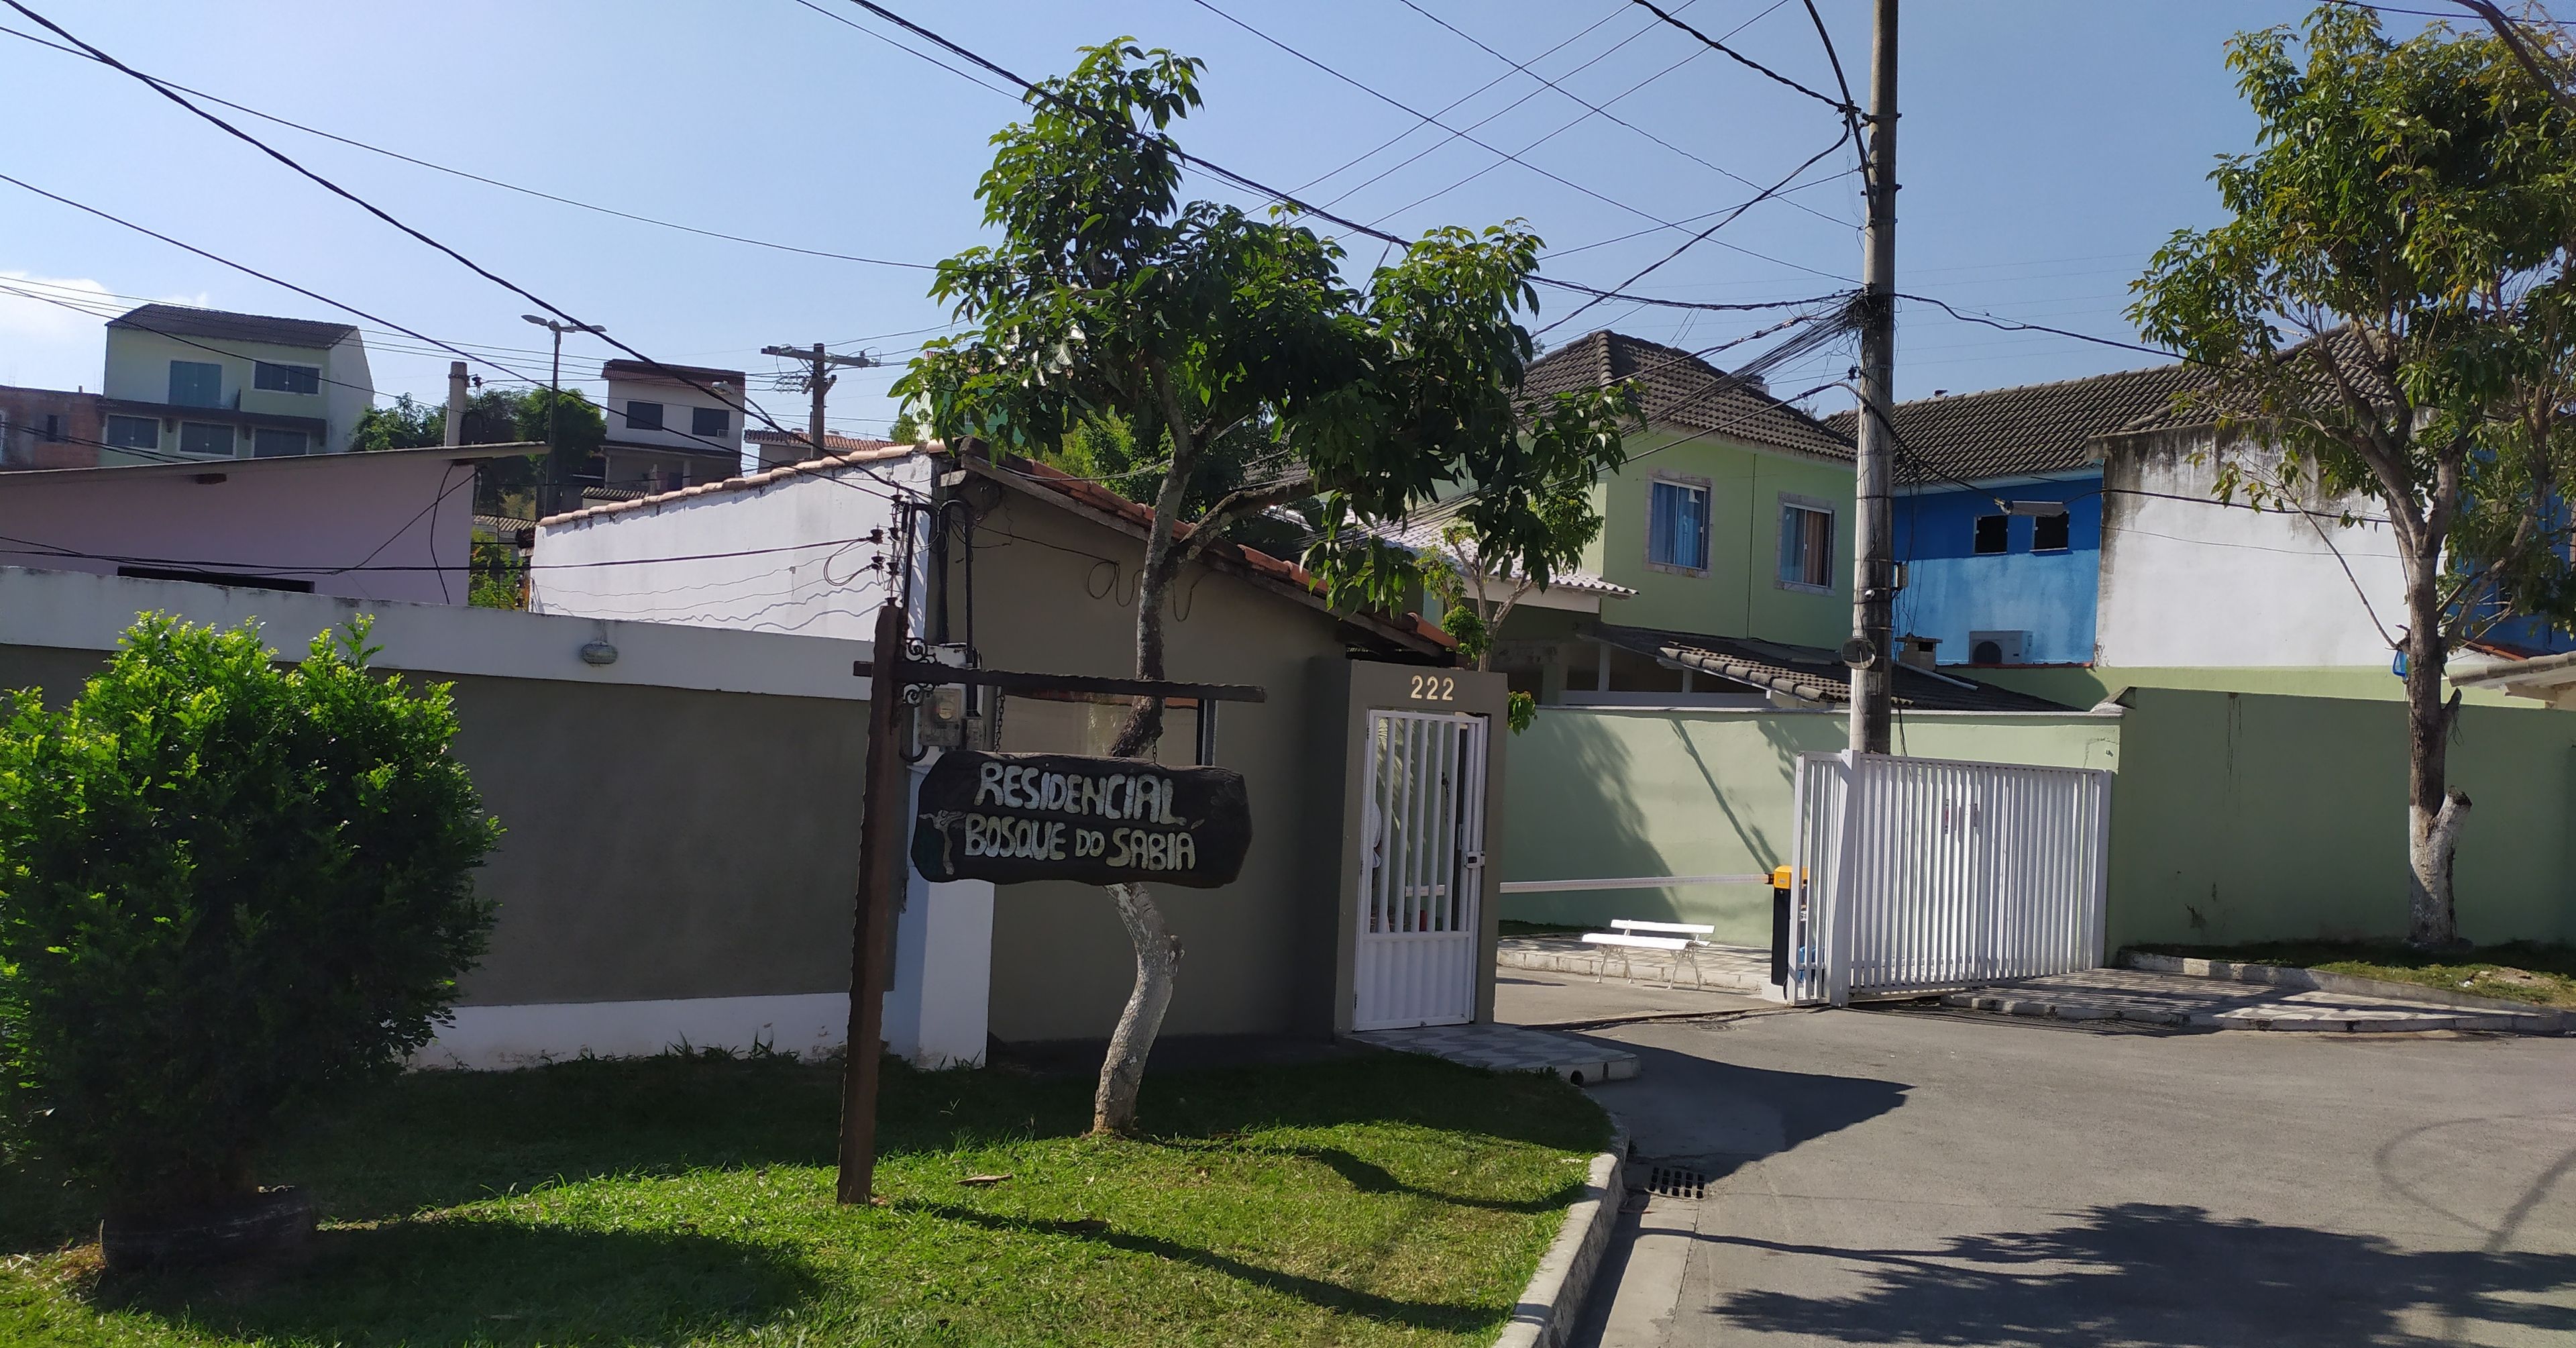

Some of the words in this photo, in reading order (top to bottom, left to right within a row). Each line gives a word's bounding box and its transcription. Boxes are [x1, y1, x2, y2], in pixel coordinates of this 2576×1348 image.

[1411, 675, 1454, 701] 222
[974, 762, 1187, 826] RESIDENCIAL
[965, 813, 1066, 860] BOSQUE
[1075, 828, 1105, 857] DO
